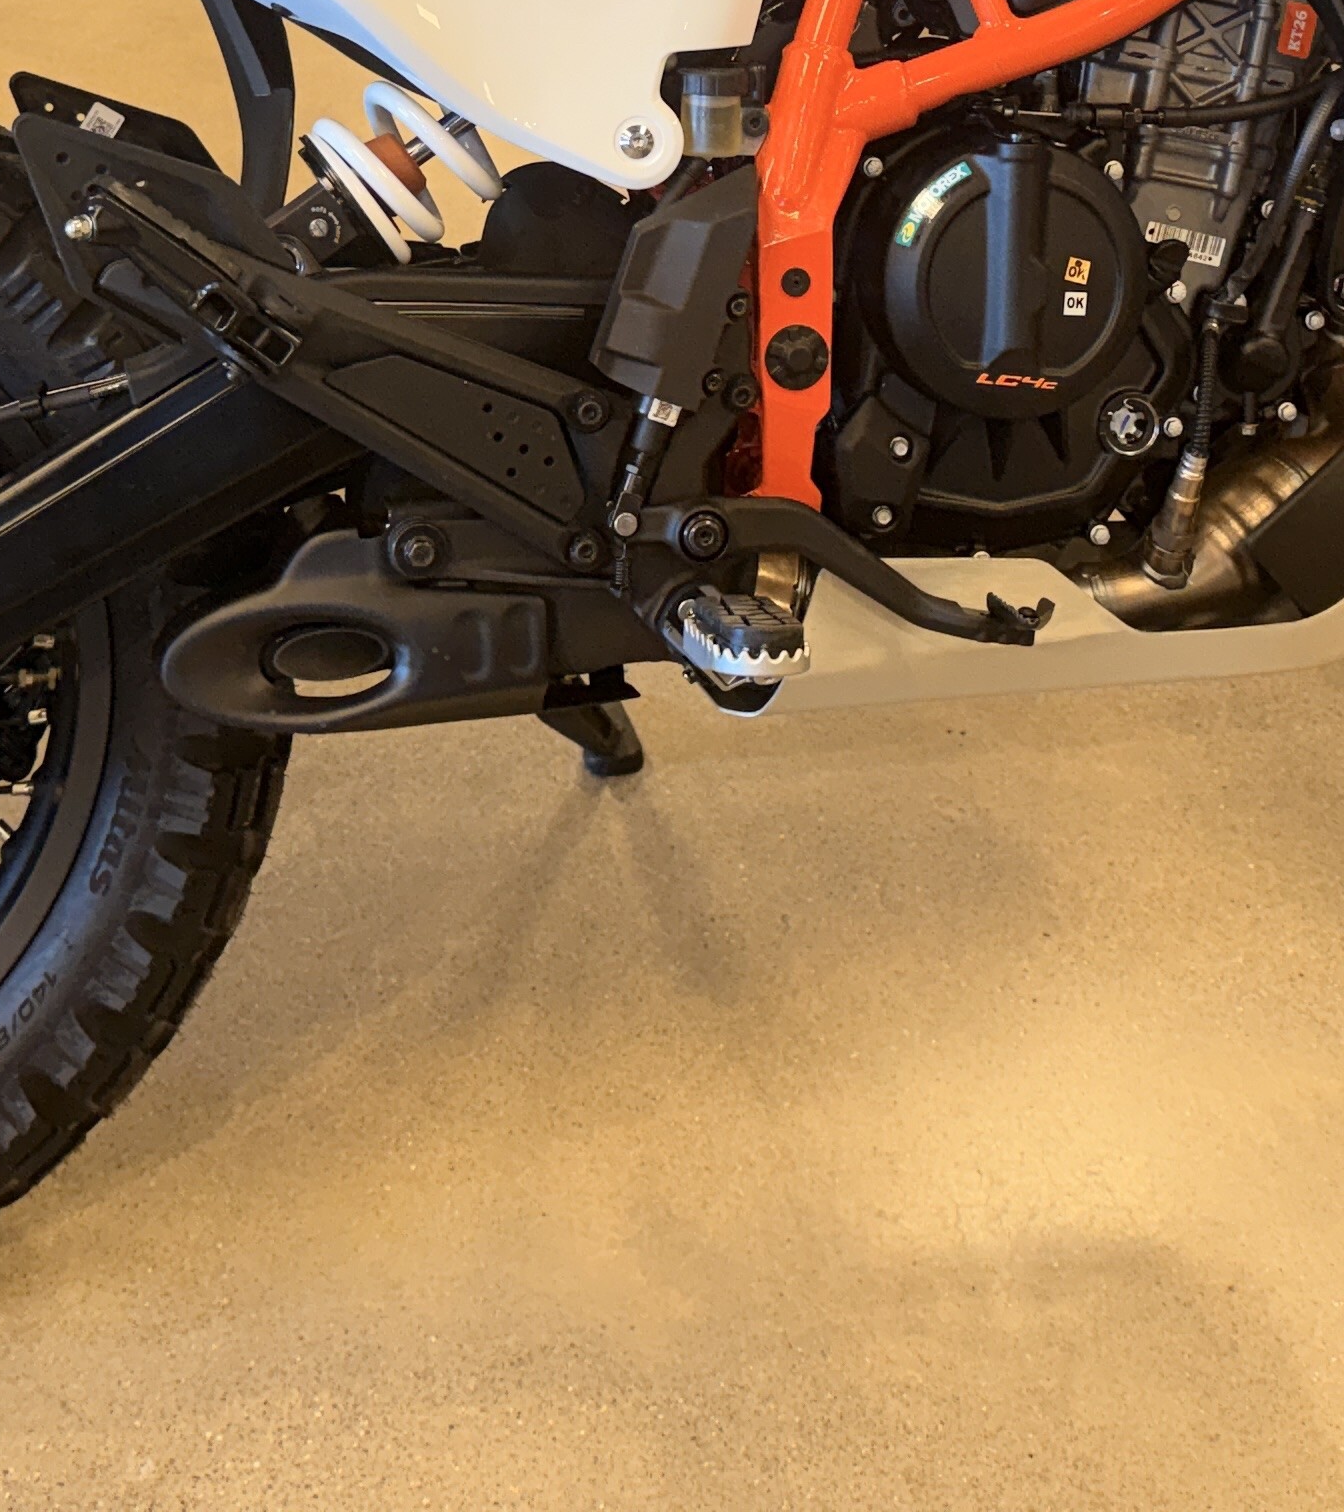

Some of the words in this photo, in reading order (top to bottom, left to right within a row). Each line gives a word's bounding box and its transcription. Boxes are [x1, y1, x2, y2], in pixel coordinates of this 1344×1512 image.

[1287, 10, 1308, 52] KT26
[908, 164, 967, 223] MOTOREX
[1067, 297, 1084, 309] OK
